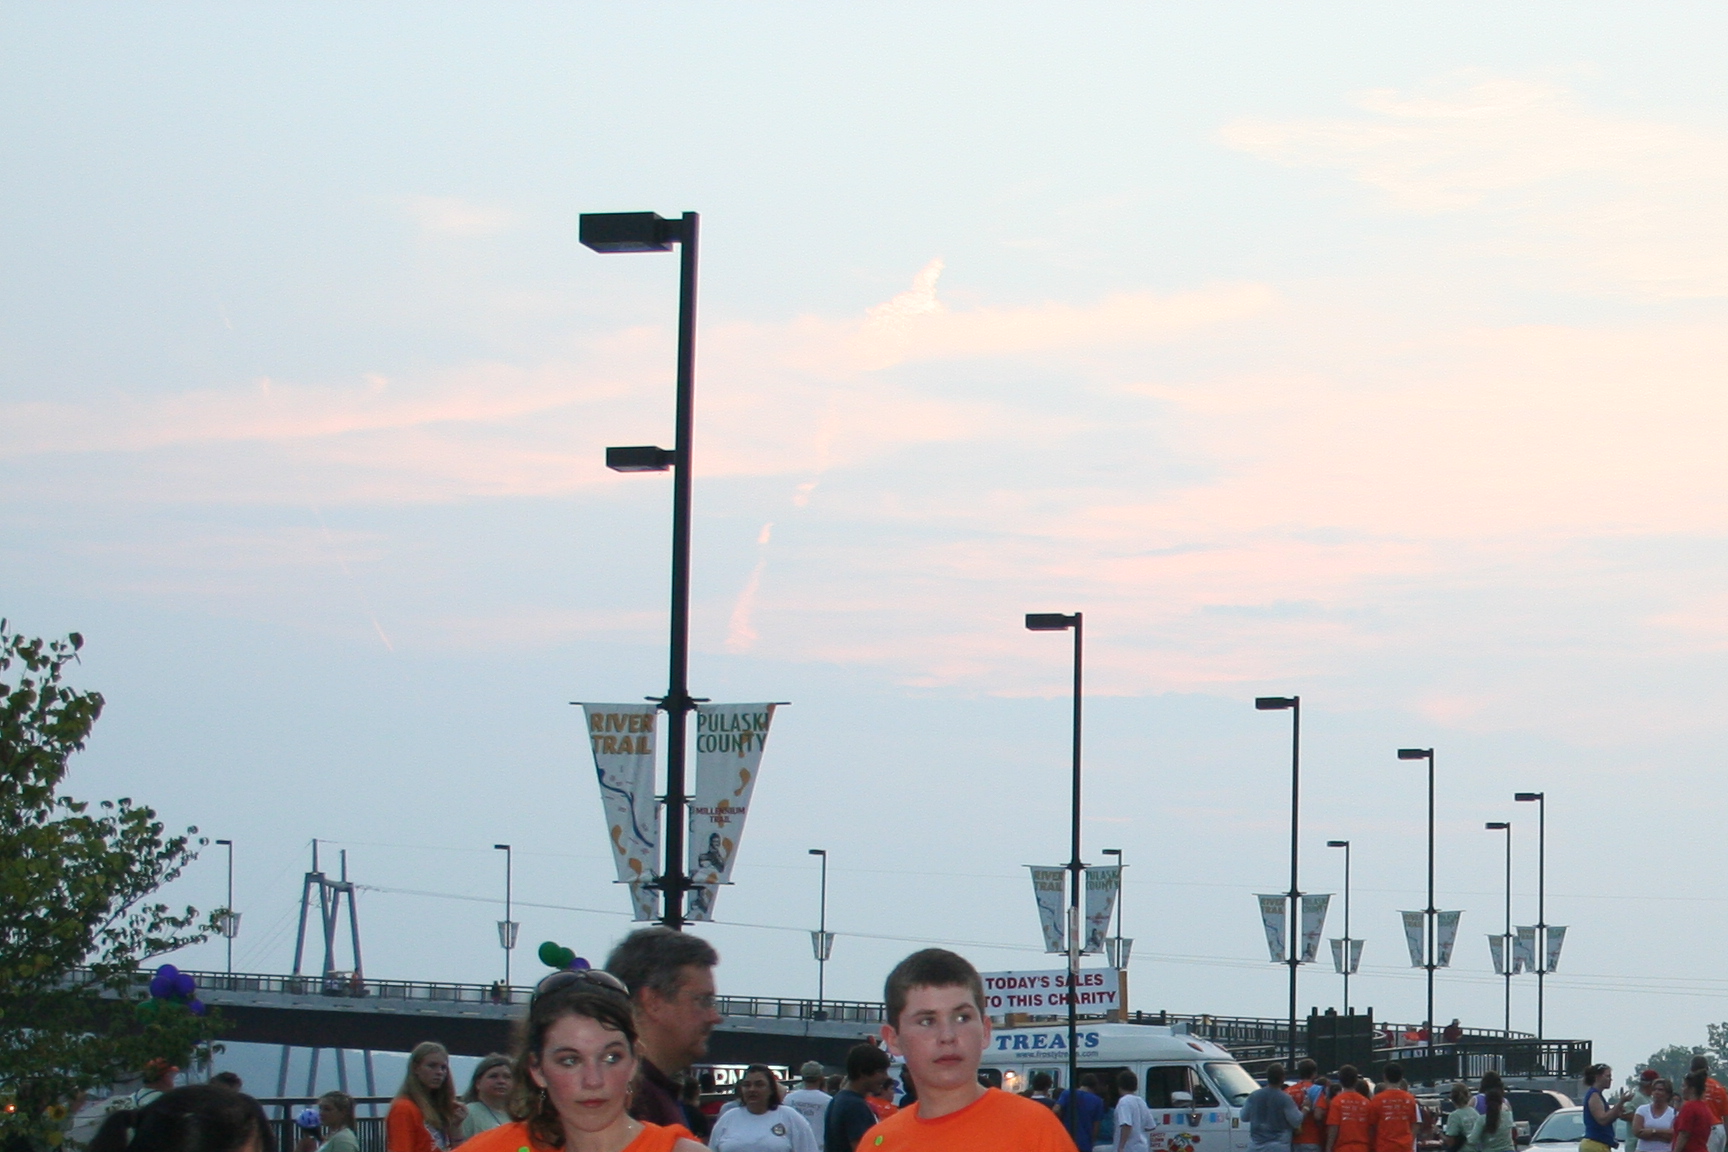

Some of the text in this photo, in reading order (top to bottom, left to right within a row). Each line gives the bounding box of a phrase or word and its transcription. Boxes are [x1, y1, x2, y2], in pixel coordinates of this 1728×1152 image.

[590, 713, 654, 733] RIVER
[697, 712, 770, 733] PULASKI
[592, 735, 653, 755] TRAIL
[697, 734, 767, 753] COUNTY
[696, 806, 746, 815] MILLENNIUM
[710, 815, 732, 824] TRAIL
[985, 976, 1050, 990] TODAY'S
[1006, 994, 1043, 1008] THIS
[1047, 991, 1117, 1005] CHRITY
